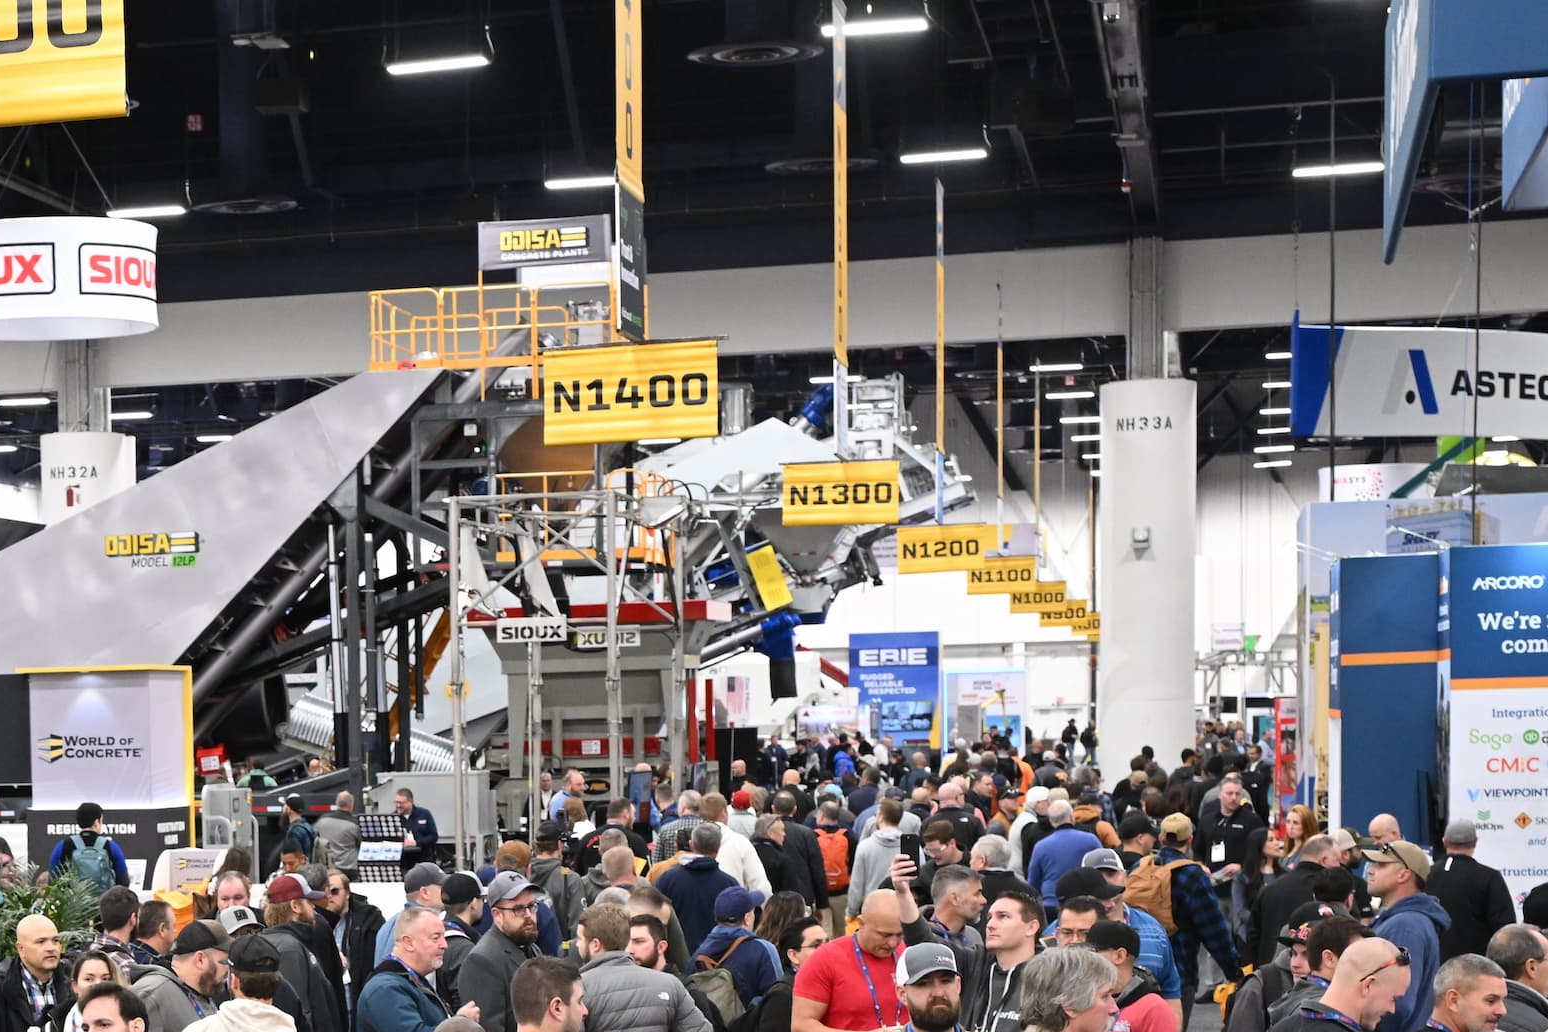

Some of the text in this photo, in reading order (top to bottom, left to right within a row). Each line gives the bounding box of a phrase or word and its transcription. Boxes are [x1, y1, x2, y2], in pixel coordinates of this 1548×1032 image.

[552, 247, 590, 259] PLANTS
[554, 373, 709, 413] N1400
[1115, 415, 1174, 432] NH33A
[49, 466, 98, 480] NH32A
[789, 482, 893, 506] N1300
[902, 539, 980, 559] N1200
[131, 556, 169, 568] MODEL
[970, 568, 1032, 582] N1100
[1472, 575, 1544, 591] ARCORO
[1011, 592, 1065, 604] N1000
[1477, 610, 1542, 631] We're
[502, 624, 562, 640] SIOUX
[64, 735, 135, 747] WORLD OF
[1468, 728, 1513, 750] Sage
[64, 747, 142, 759] CONCRETE
